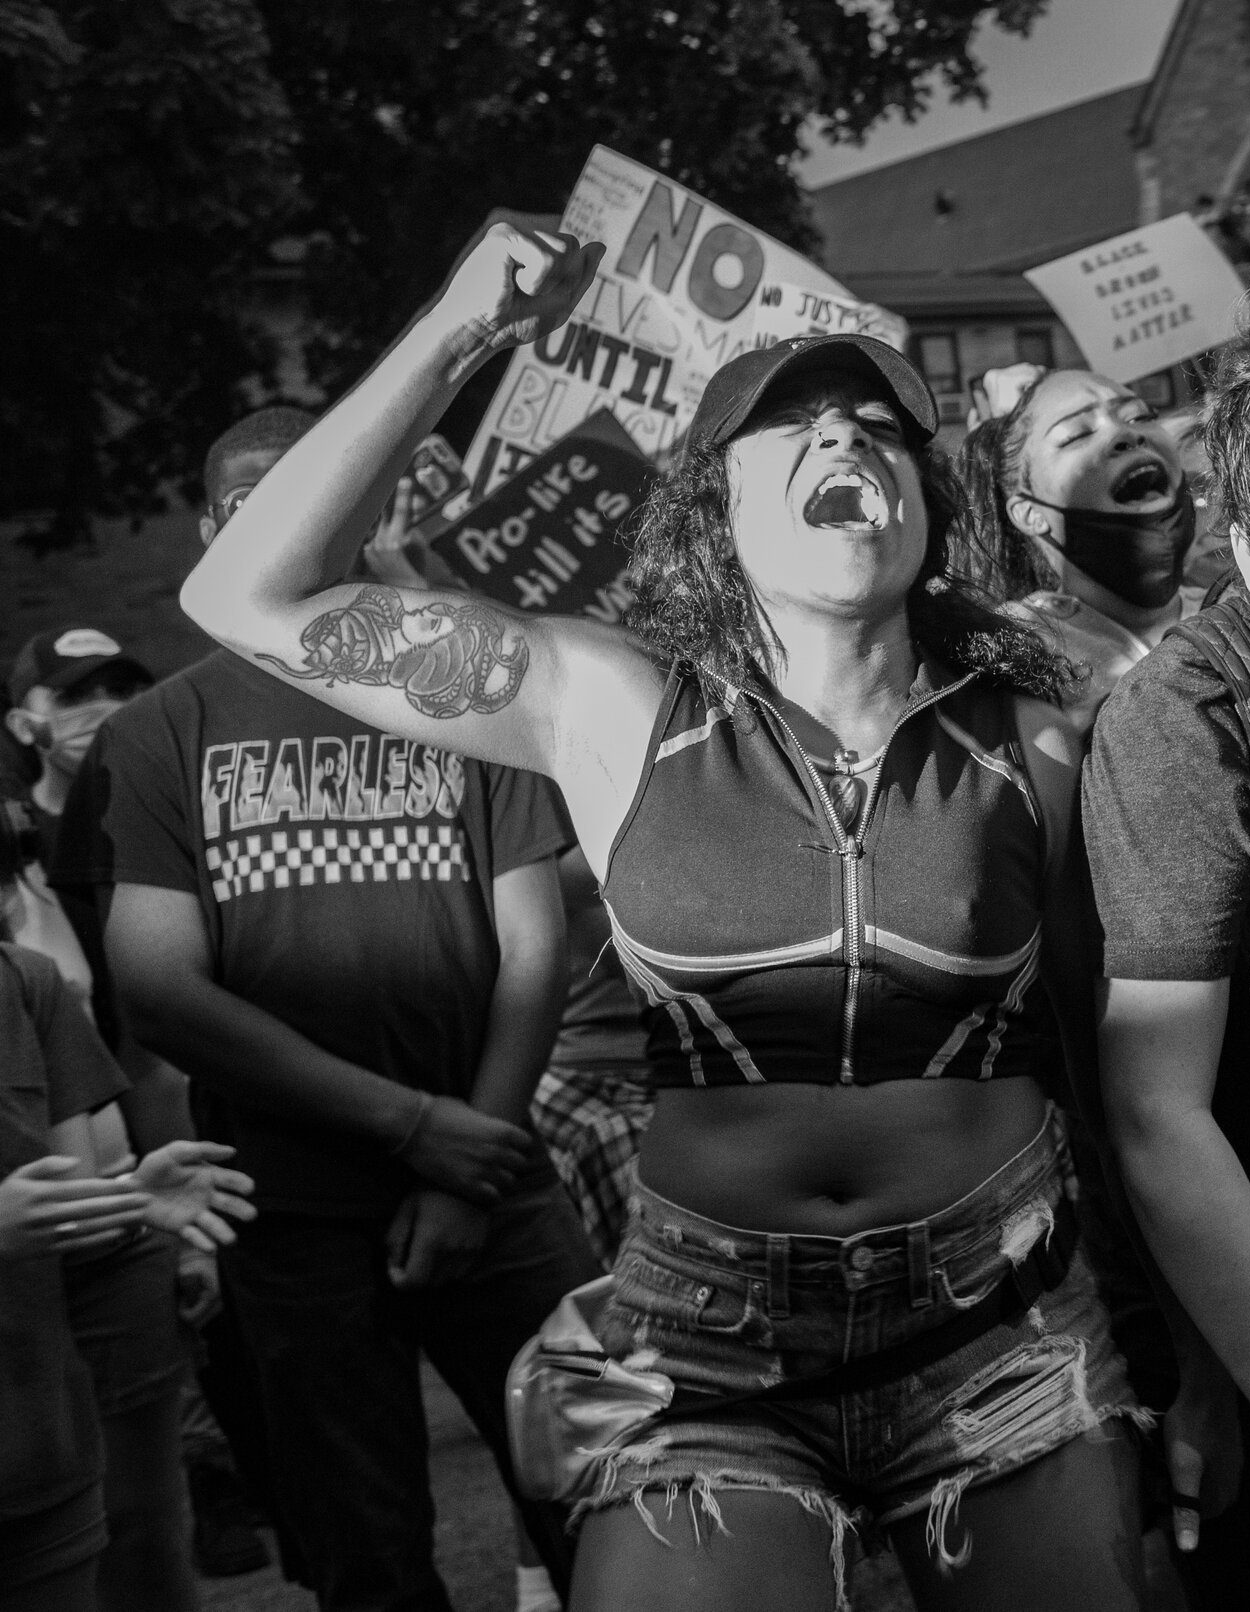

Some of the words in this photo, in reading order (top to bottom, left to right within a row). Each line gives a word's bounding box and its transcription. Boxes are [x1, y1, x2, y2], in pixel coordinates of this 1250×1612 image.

[615, 179, 765, 322] NO
[760, 287, 782, 307] NO
[533, 322, 678, 417] UNTIL
[512, 535, 581, 608] till
[202, 733, 466, 840] FEARLESS
